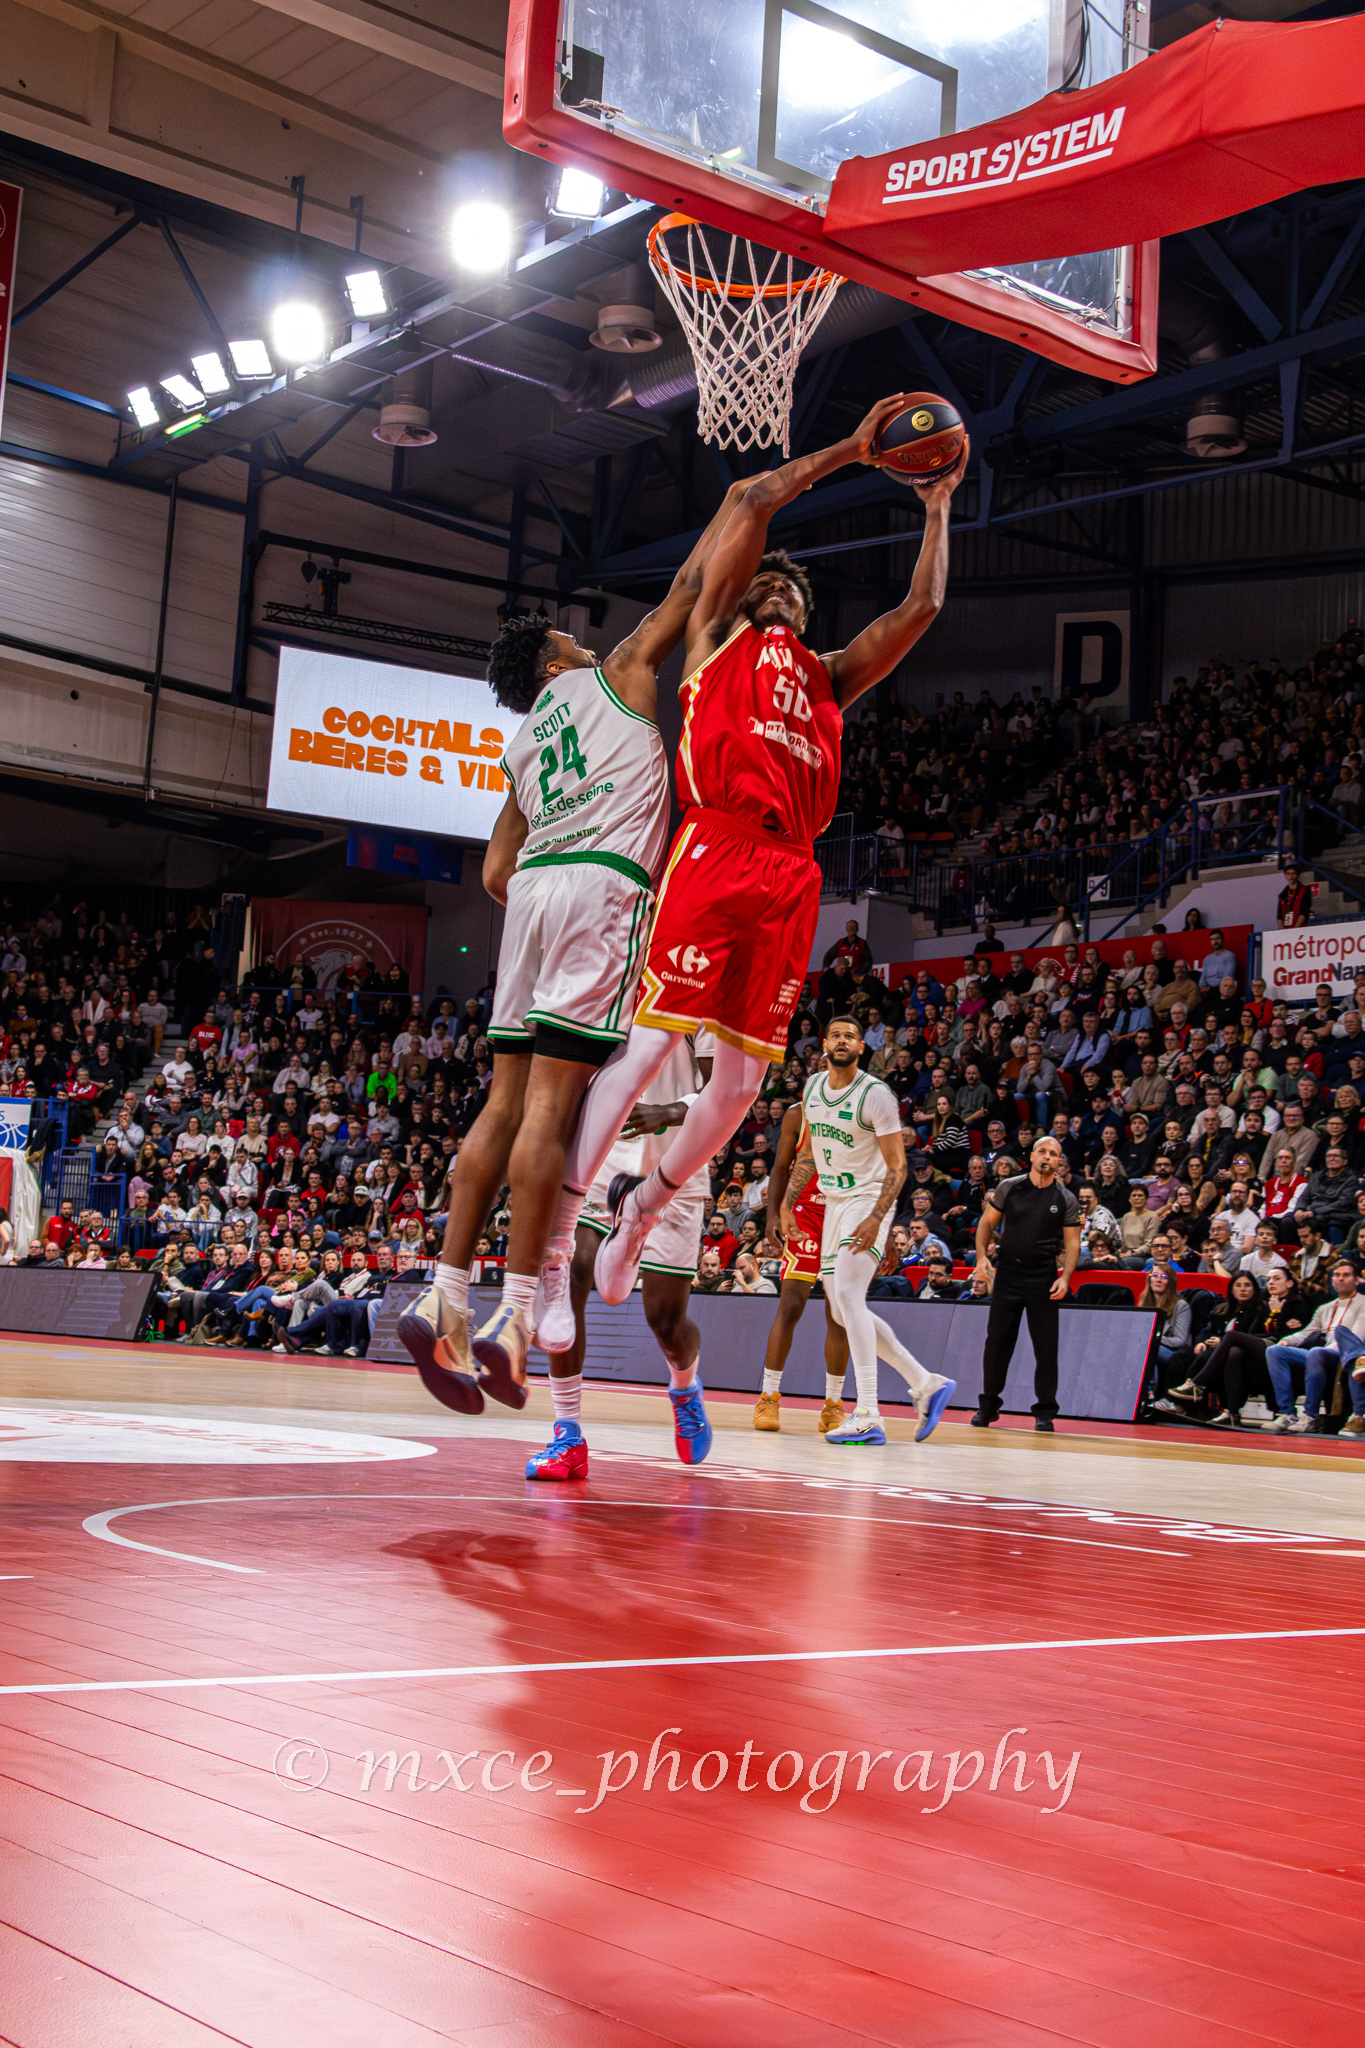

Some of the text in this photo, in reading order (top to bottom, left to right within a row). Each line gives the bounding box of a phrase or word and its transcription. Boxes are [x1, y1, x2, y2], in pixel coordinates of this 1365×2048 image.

[886, 106, 1126, 192] SPORT SYSTEM
[1061, 620, 1123, 699] D
[322, 706, 504, 759] COCKTAILS
[533, 702, 572, 743] SCOTT
[288, 727, 512, 793] BIERES & VIN
[538, 724, 588, 806] 24
[660, 970, 706, 989] Carrefour
[822, 1148, 832, 1167] 12
